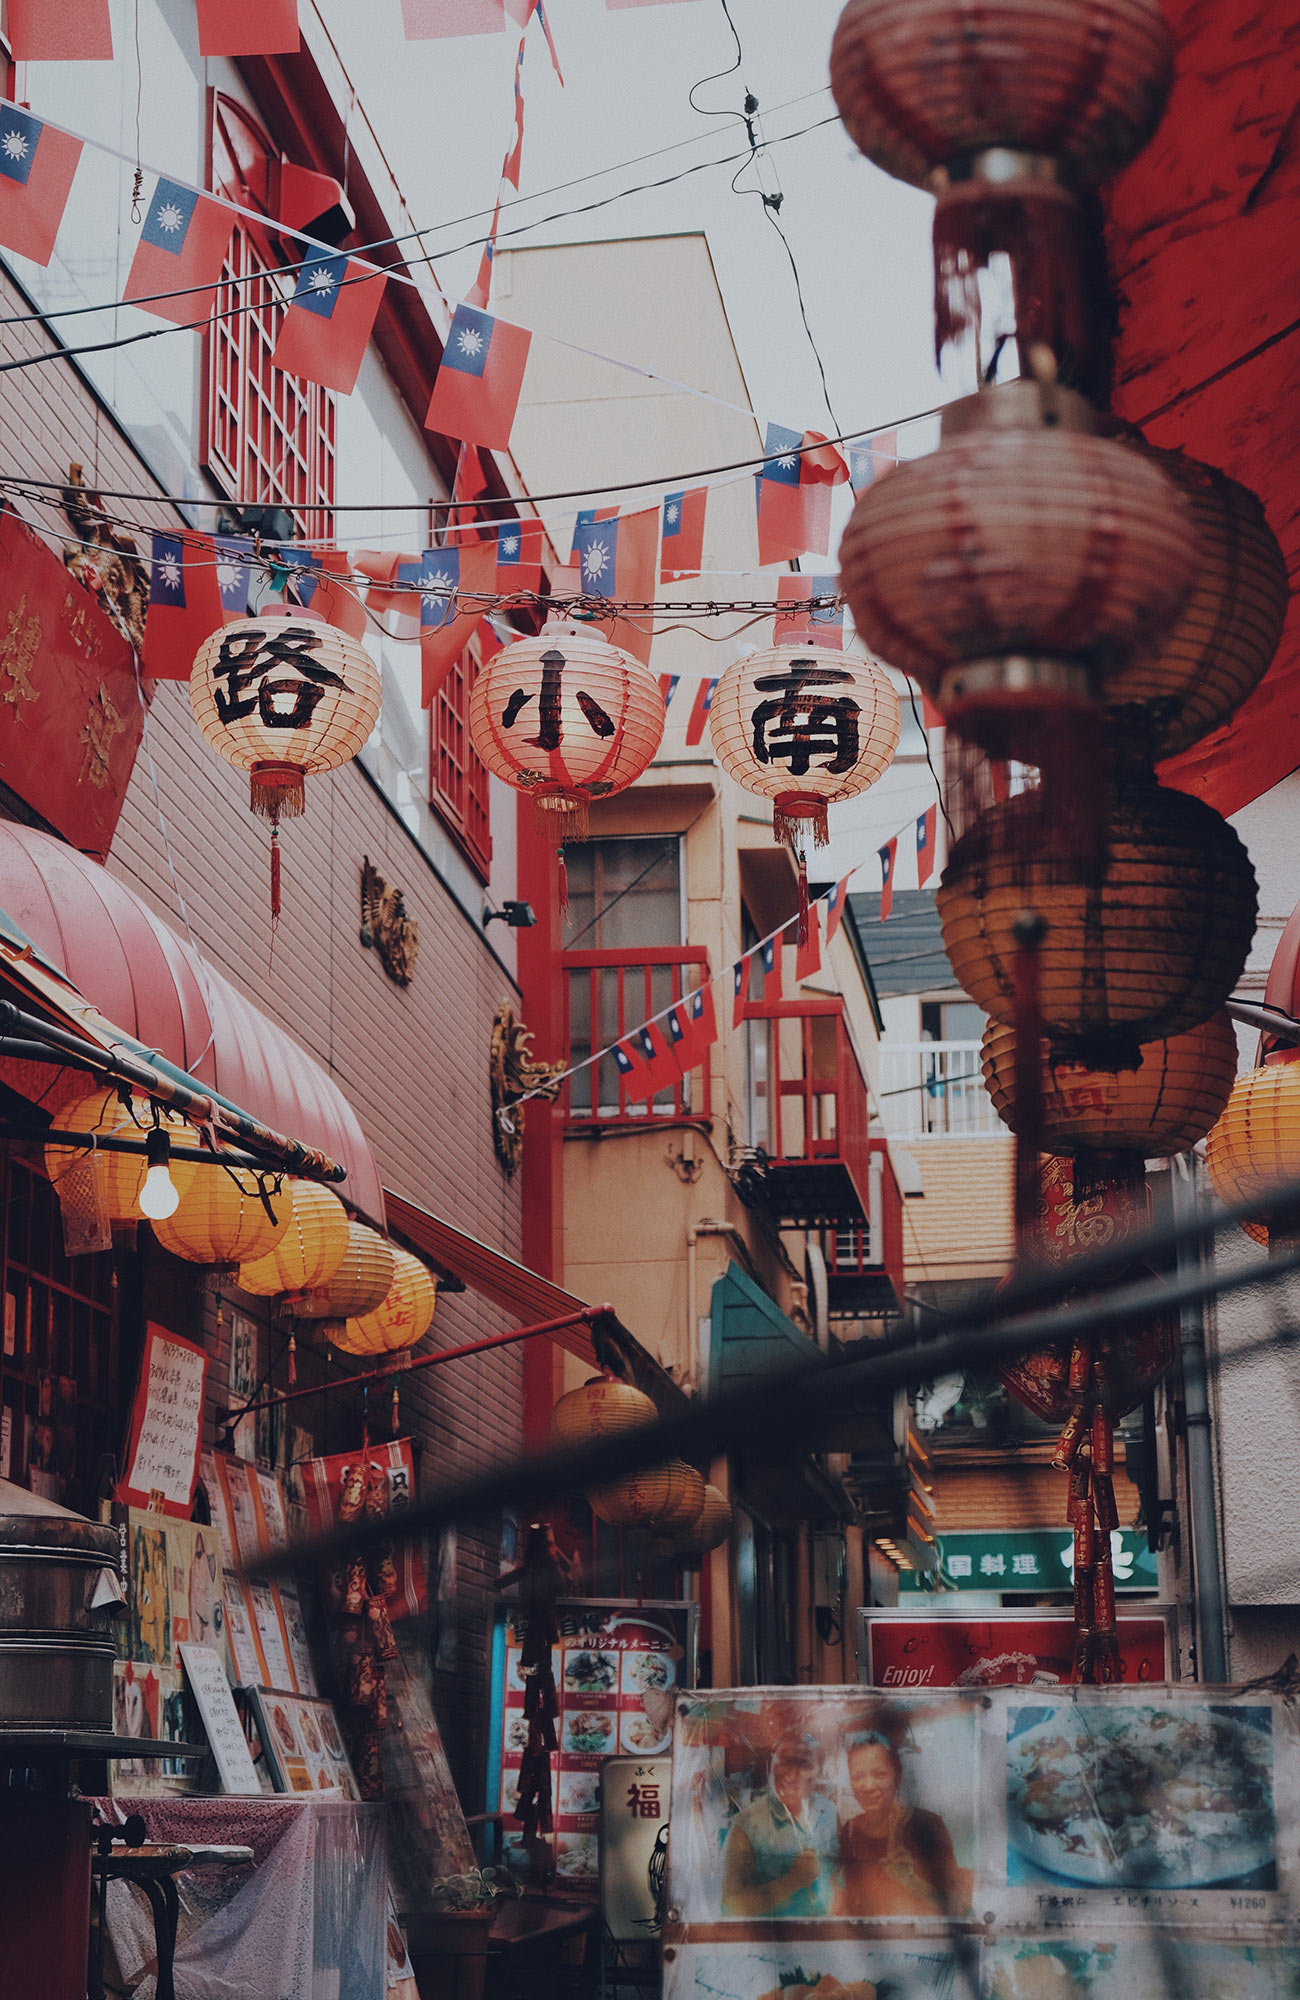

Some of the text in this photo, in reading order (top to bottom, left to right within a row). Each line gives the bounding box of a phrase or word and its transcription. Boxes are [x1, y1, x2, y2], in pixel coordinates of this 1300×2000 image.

[213, 627, 355, 730] 路
[501, 649, 616, 752] 小
[752, 659, 863, 777] 南
[924, 1553, 1040, 1579] 国料理
[882, 1664, 935, 1688] Enjoy!
[634, 1766, 656, 1778] ふく
[627, 1783, 661, 1820] 福
